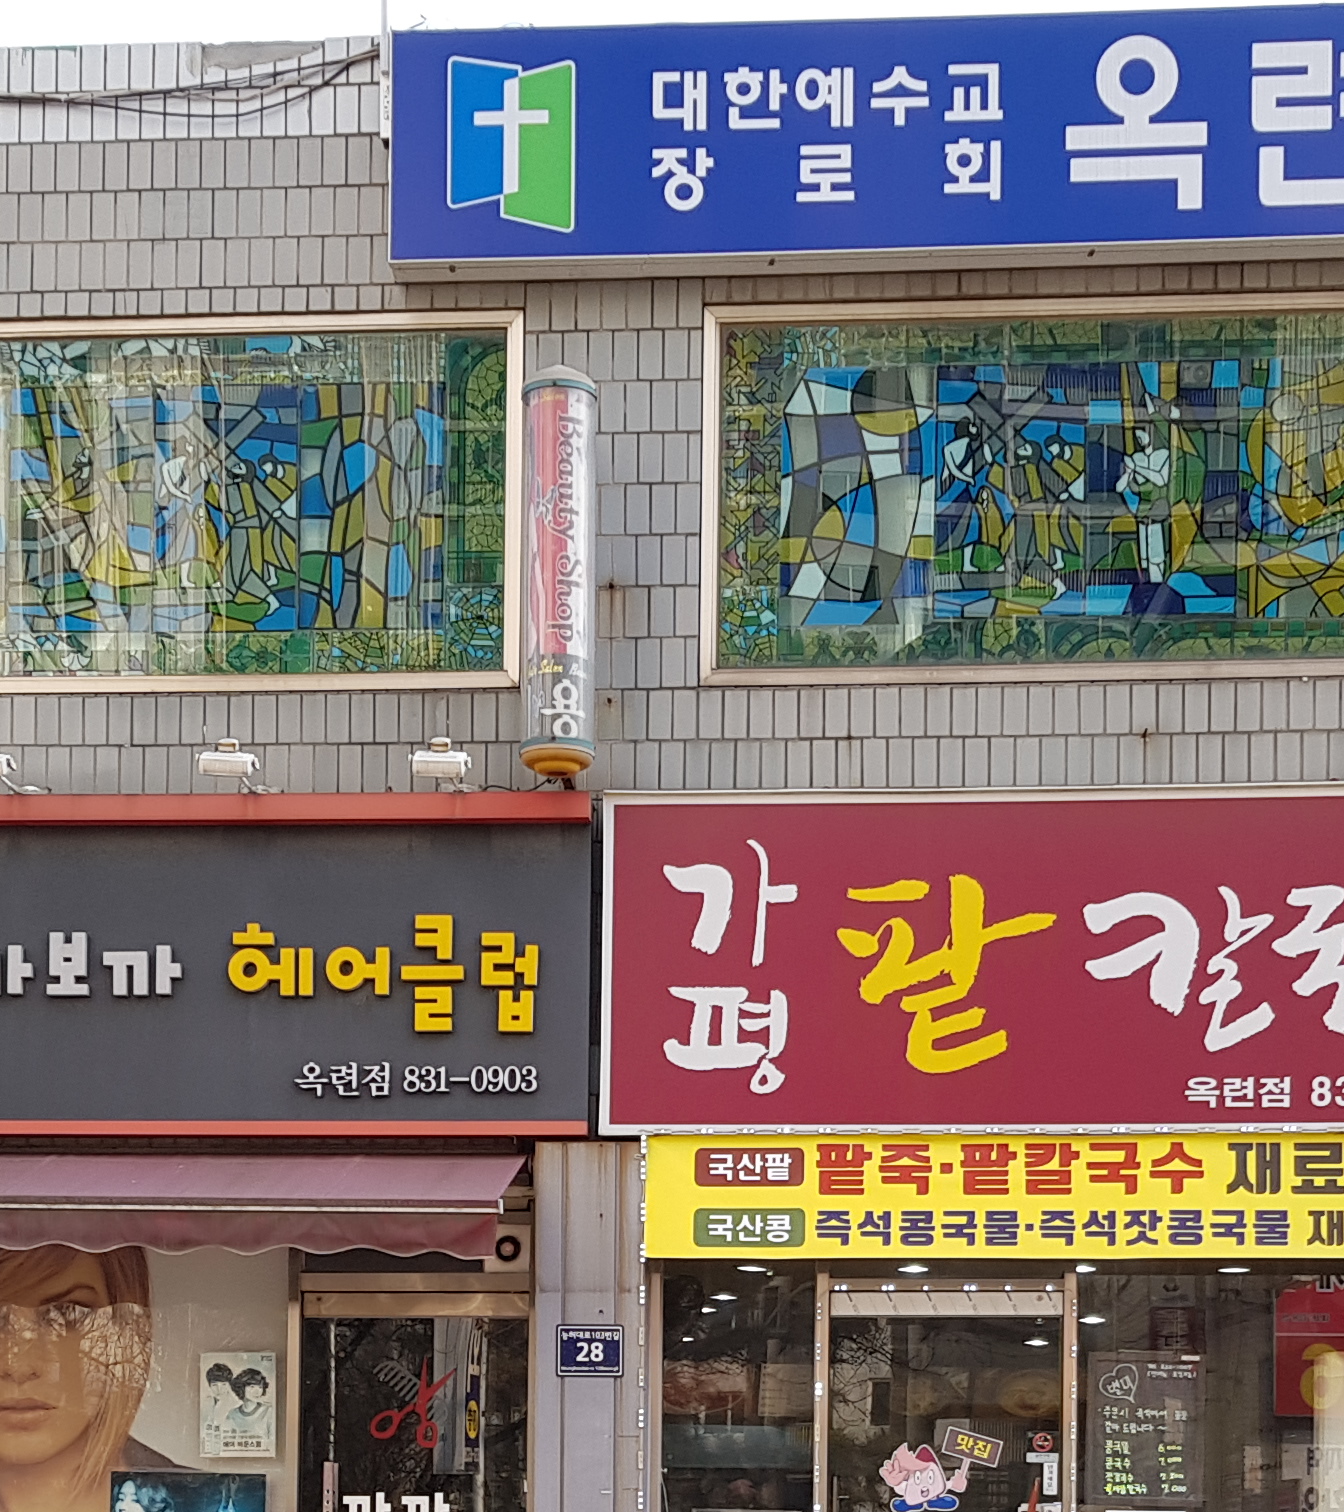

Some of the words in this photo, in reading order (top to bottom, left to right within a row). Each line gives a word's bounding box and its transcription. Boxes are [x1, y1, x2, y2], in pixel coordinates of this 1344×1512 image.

[651, 61, 1004, 133] 대한예수교
[651, 138, 1004, 212] 장로회
[547, 410, 585, 546] Beauty
[546, 552, 585, 645] Shop
[227, 914, 540, 1034] 헤어클럽
[662, 838, 799, 1095] 가평
[837, 873, 1056, 1076] 팥
[293, 1061, 392, 1098] 옥련점
[402, 1066, 539, 1095] 831-0903
[1183, 1074, 1292, 1110] 옥련점
[706, 1151, 794, 1184] 국산팥
[814, 1141, 1206, 1197] 팥죽·팥칼국수
[706, 1212, 793, 1244] 국산콩
[575, 1341, 604, 1362] 28
[955, 1433, 993, 1459] 맛집
